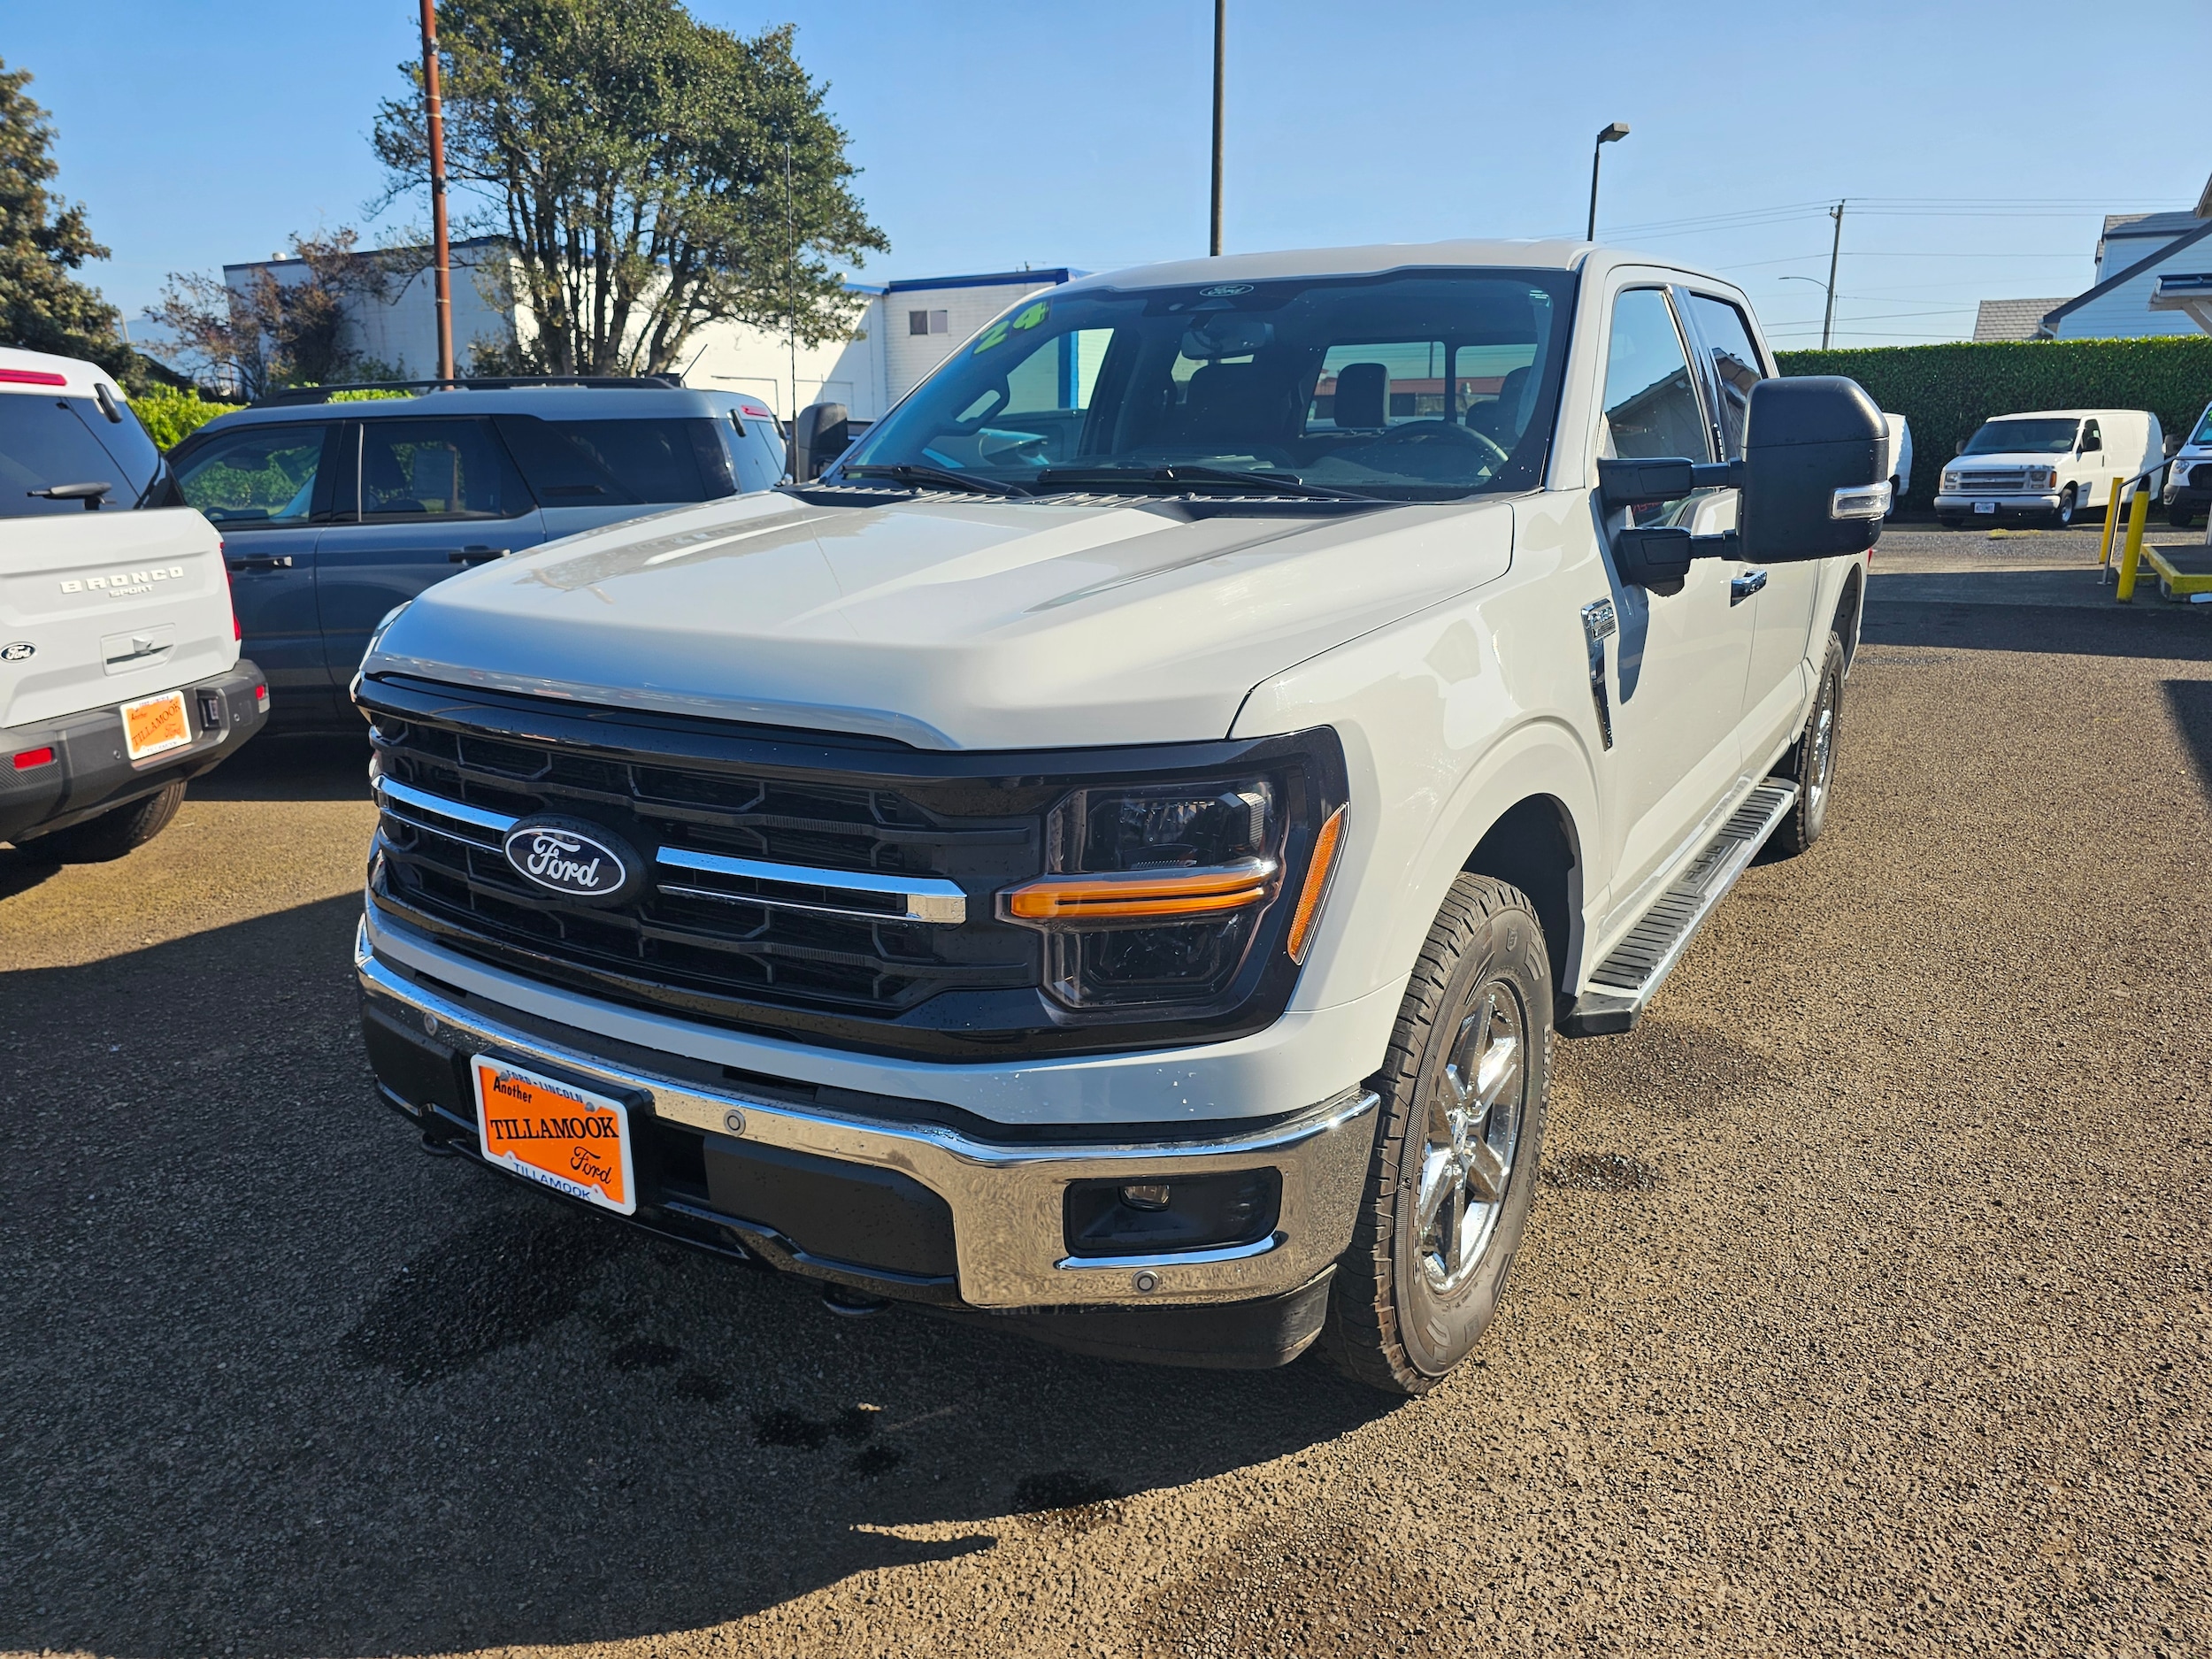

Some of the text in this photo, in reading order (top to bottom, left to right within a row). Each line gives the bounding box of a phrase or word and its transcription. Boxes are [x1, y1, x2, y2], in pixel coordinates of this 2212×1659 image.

[973, 301, 1049, 355] 24
[59, 566, 185, 595] BRONCO
[109, 584, 154, 598] SPORT
[5, 645, 32, 660] Ford
[131, 700, 181, 747] TILLAMOOK
[526, 835, 601, 887] Ford
[493, 1075, 533, 1104] Another
[505, 1070, 584, 1104] FORD LINCOLN
[490, 1117, 619, 1141] TILLAMOOK
[512, 1161, 592, 1201] TILLAMOOK
[570, 1146, 612, 1185] Ford
